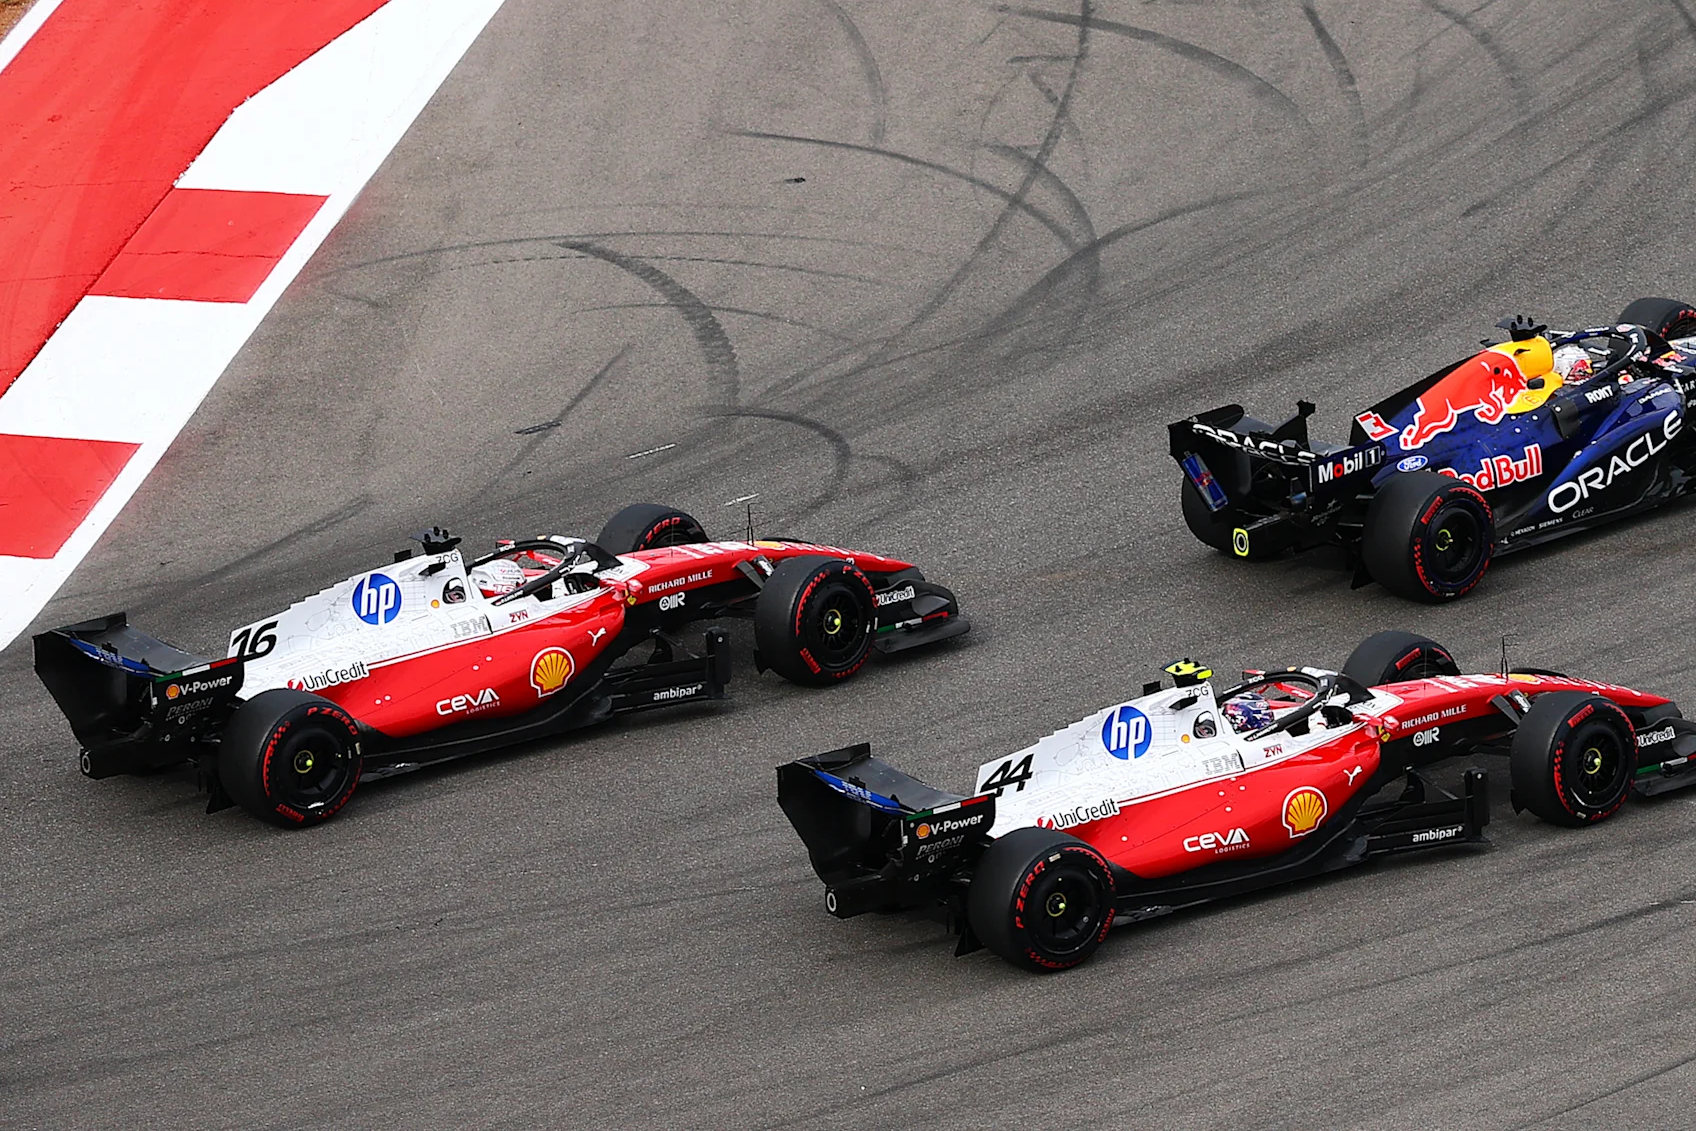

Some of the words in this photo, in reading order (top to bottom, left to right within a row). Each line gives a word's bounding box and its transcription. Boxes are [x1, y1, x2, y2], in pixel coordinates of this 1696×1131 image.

[1637, 386, 1672, 405] DAMAC
[1192, 423, 1316, 467] ORACLE
[1318, 455, 1363, 484] Mobil
[1402, 457, 1423, 470] Ford
[1495, 443, 1543, 487] Bull
[1548, 409, 1684, 514] ORACLE
[648, 576, 686, 594] RICHARD
[687, 569, 713, 583] MILLE
[360, 573, 396, 625] hp
[450, 616, 489, 638] IBM
[509, 609, 529, 623] ZYN
[231, 620, 279, 663] 16
[180, 675, 233, 695] V-Power
[302, 660, 368, 690] UniCredit
[652, 686, 697, 701] ambipar
[166, 696, 214, 717] PERONI
[466, 701, 501, 715] LOGISTICS
[1401, 715, 1439, 730] RICHARD
[1441, 703, 1467, 718] MILLE
[320, 706, 358, 736] ZERO
[1109, 705, 1146, 761] hp
[1263, 743, 1283, 758] ZYN
[979, 753, 1035, 798] 44
[1201, 752, 1241, 776] IBM
[930, 814, 984, 835] V-Power
[1052, 798, 1119, 829] UniCredit
[916, 834, 965, 856] PERONI
[1412, 826, 1458, 843] ambipar
[1214, 842, 1250, 855] LOGISTICS
[1015, 860, 1046, 912] ZERO
